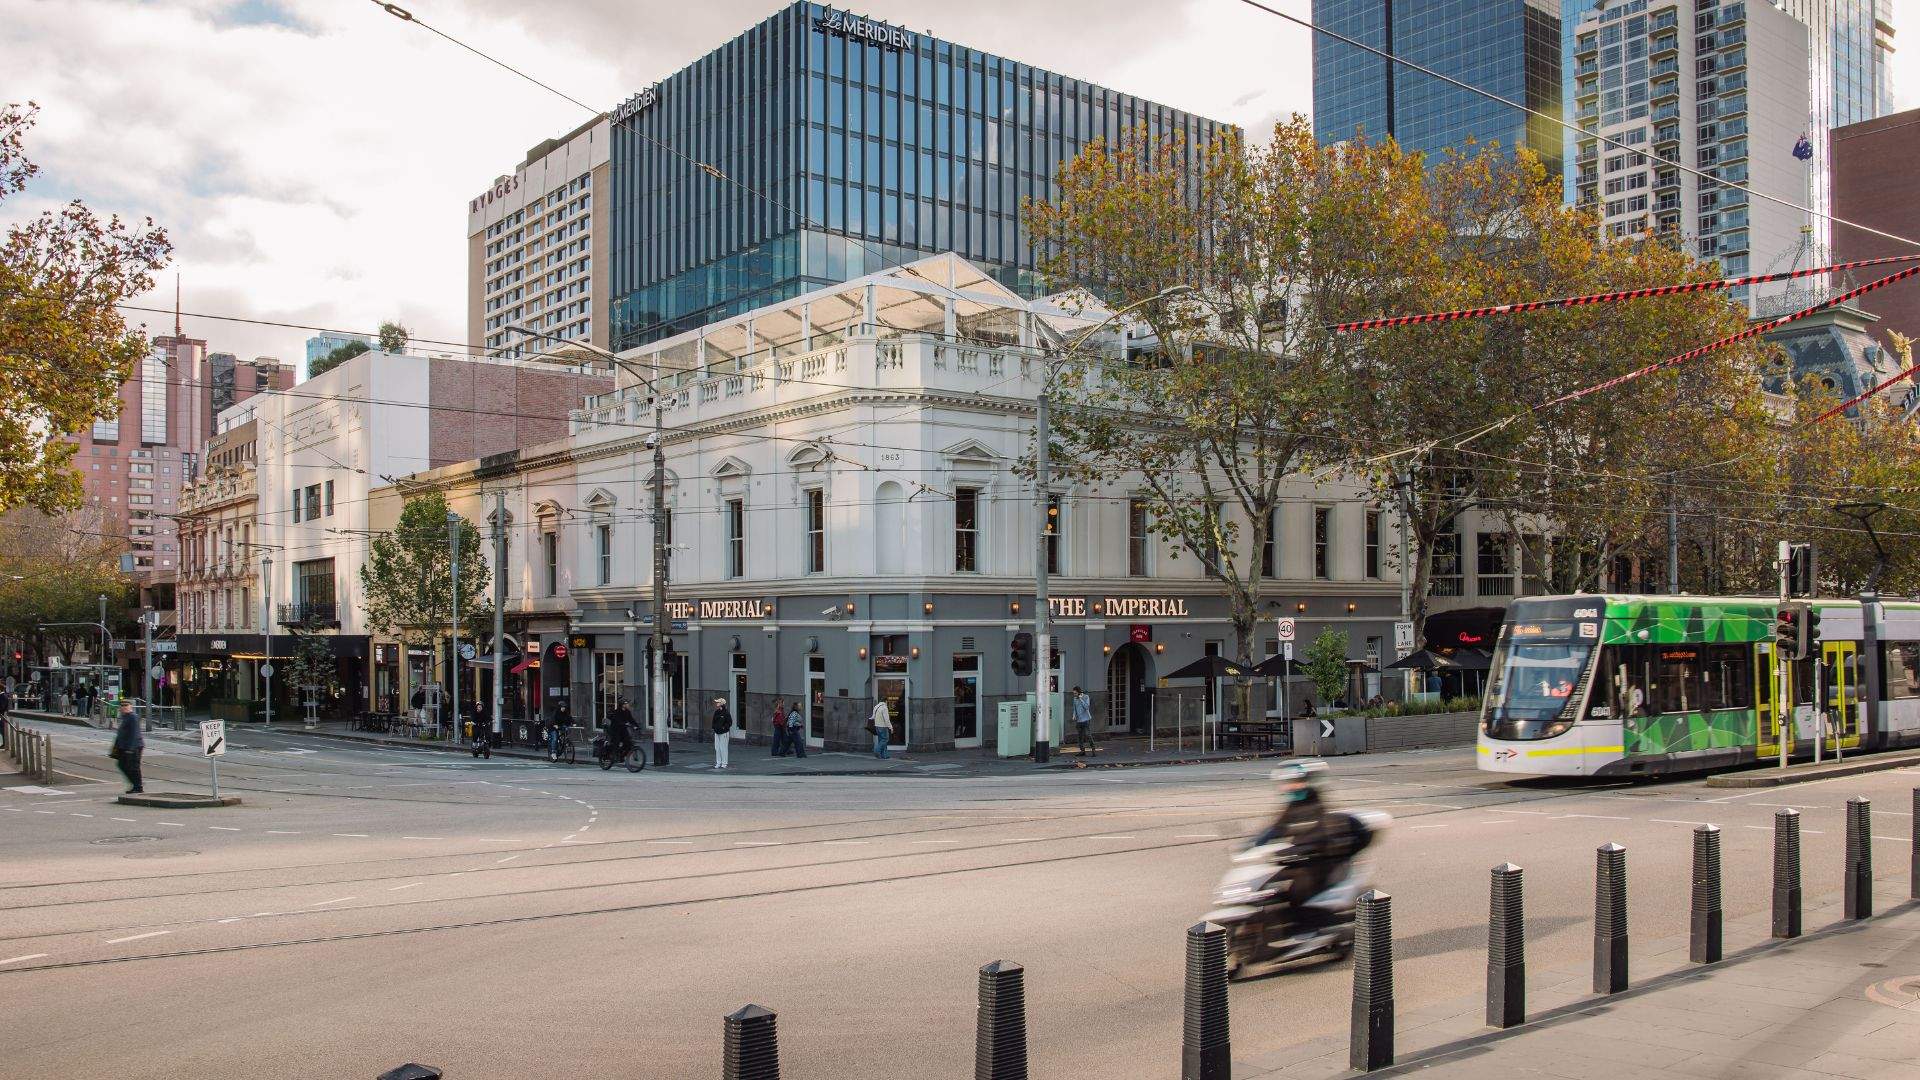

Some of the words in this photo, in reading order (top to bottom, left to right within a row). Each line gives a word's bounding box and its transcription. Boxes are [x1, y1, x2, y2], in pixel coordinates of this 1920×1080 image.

[842, 17, 912, 50] MERIDIEN
[619, 87, 656, 122] MERIDEN
[472, 174, 519, 213] RYDGES
[664, 602, 689, 619] THE
[700, 600, 764, 618] IMPERIAL
[1048, 598, 1086, 616] THE
[1105, 598, 1188, 616] IMPERIAL
[1280, 624, 1292, 633] 40
[1402, 631, 1406, 640] 1
